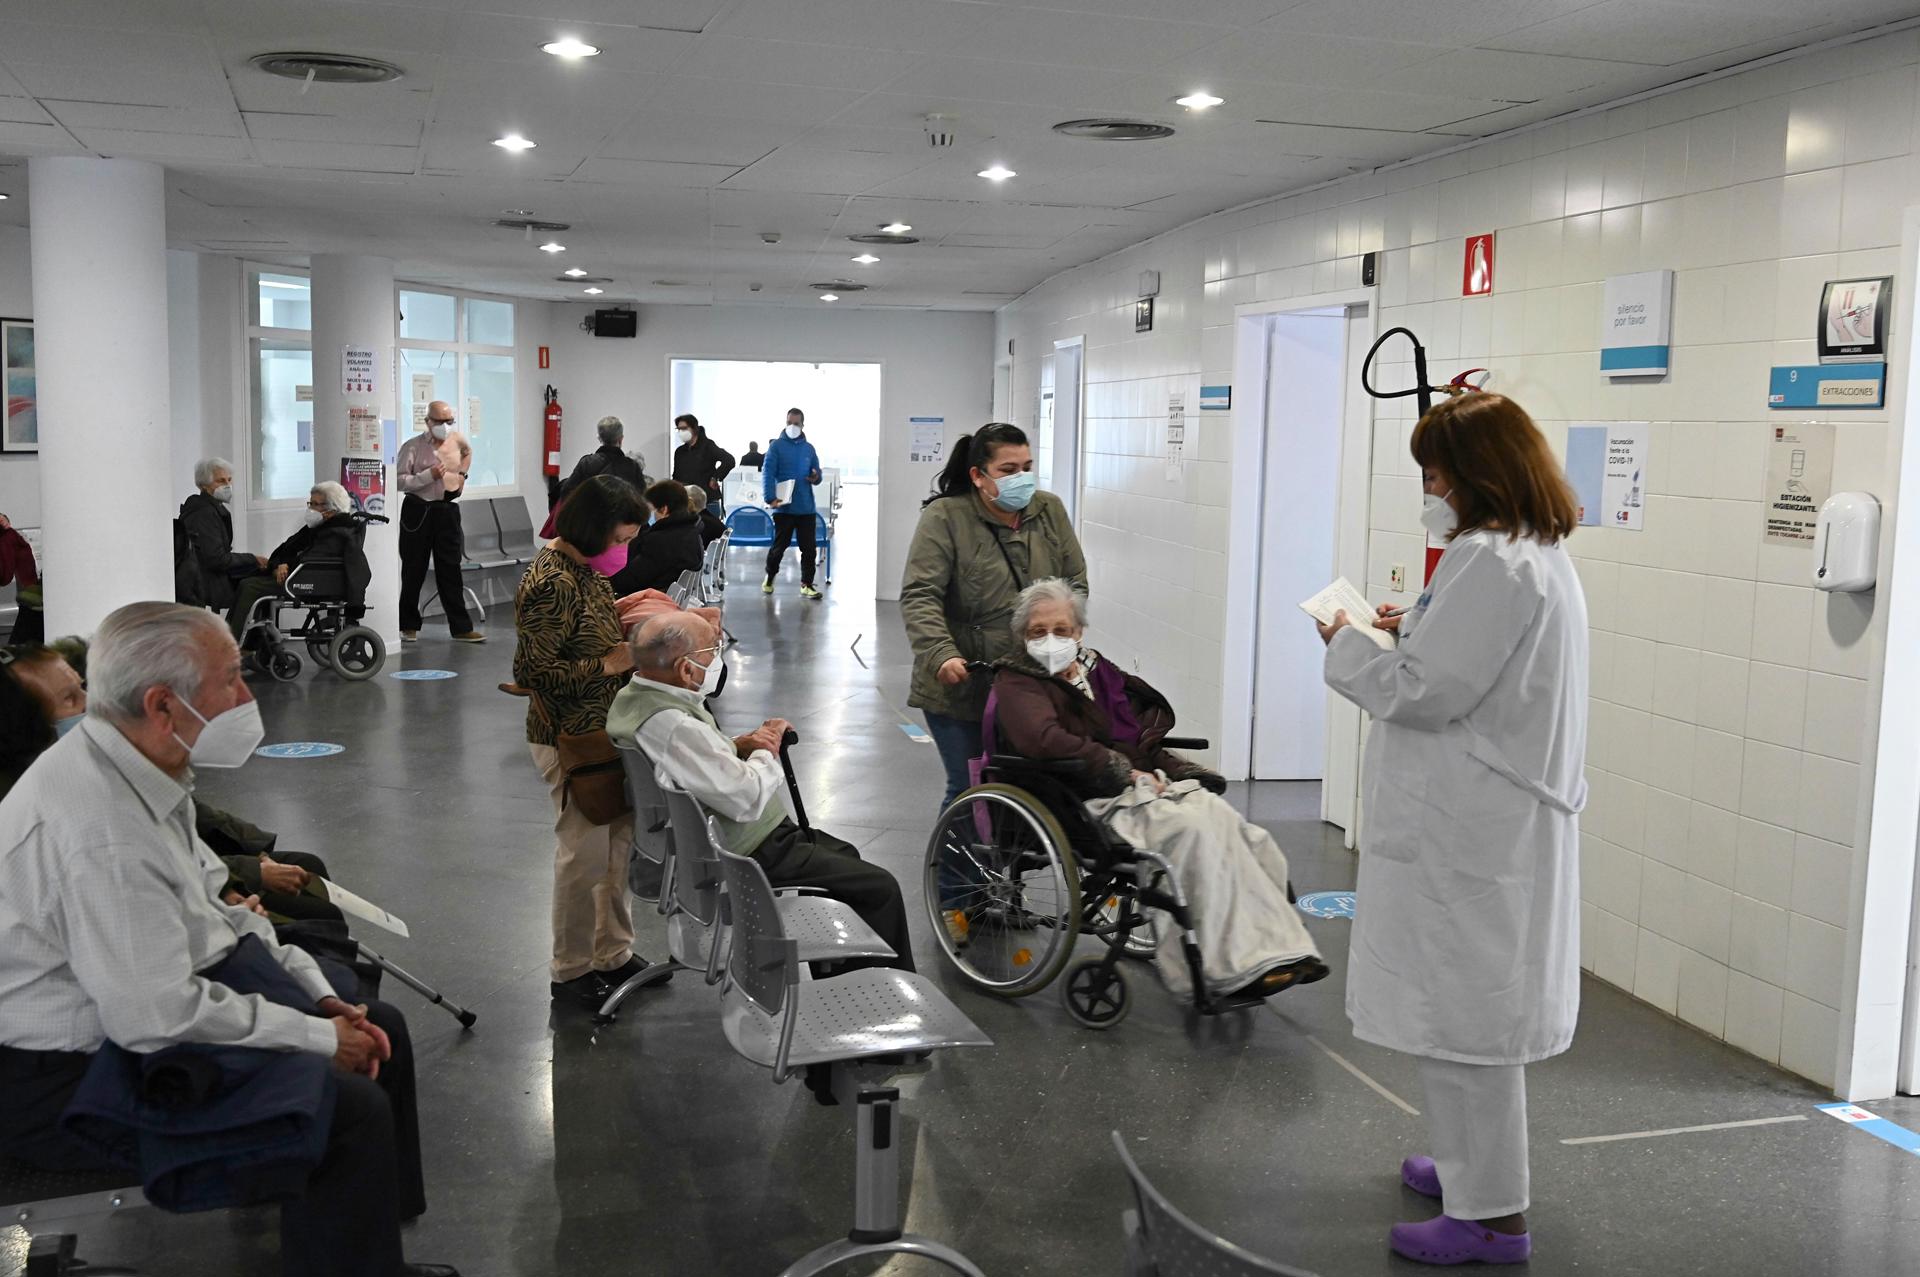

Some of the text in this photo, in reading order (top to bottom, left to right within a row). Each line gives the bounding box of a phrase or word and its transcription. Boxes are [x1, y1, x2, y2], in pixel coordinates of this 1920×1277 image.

[1617, 303, 1645, 314] silencio
[1614, 315, 1647, 329] por favor
[1790, 370, 1797, 383] 9
[1823, 387, 1873, 396] EXTRACCIONES
[1608, 456, 1633, 464] COVID-19
[1780, 494, 1812, 503] ESTACIÓN
